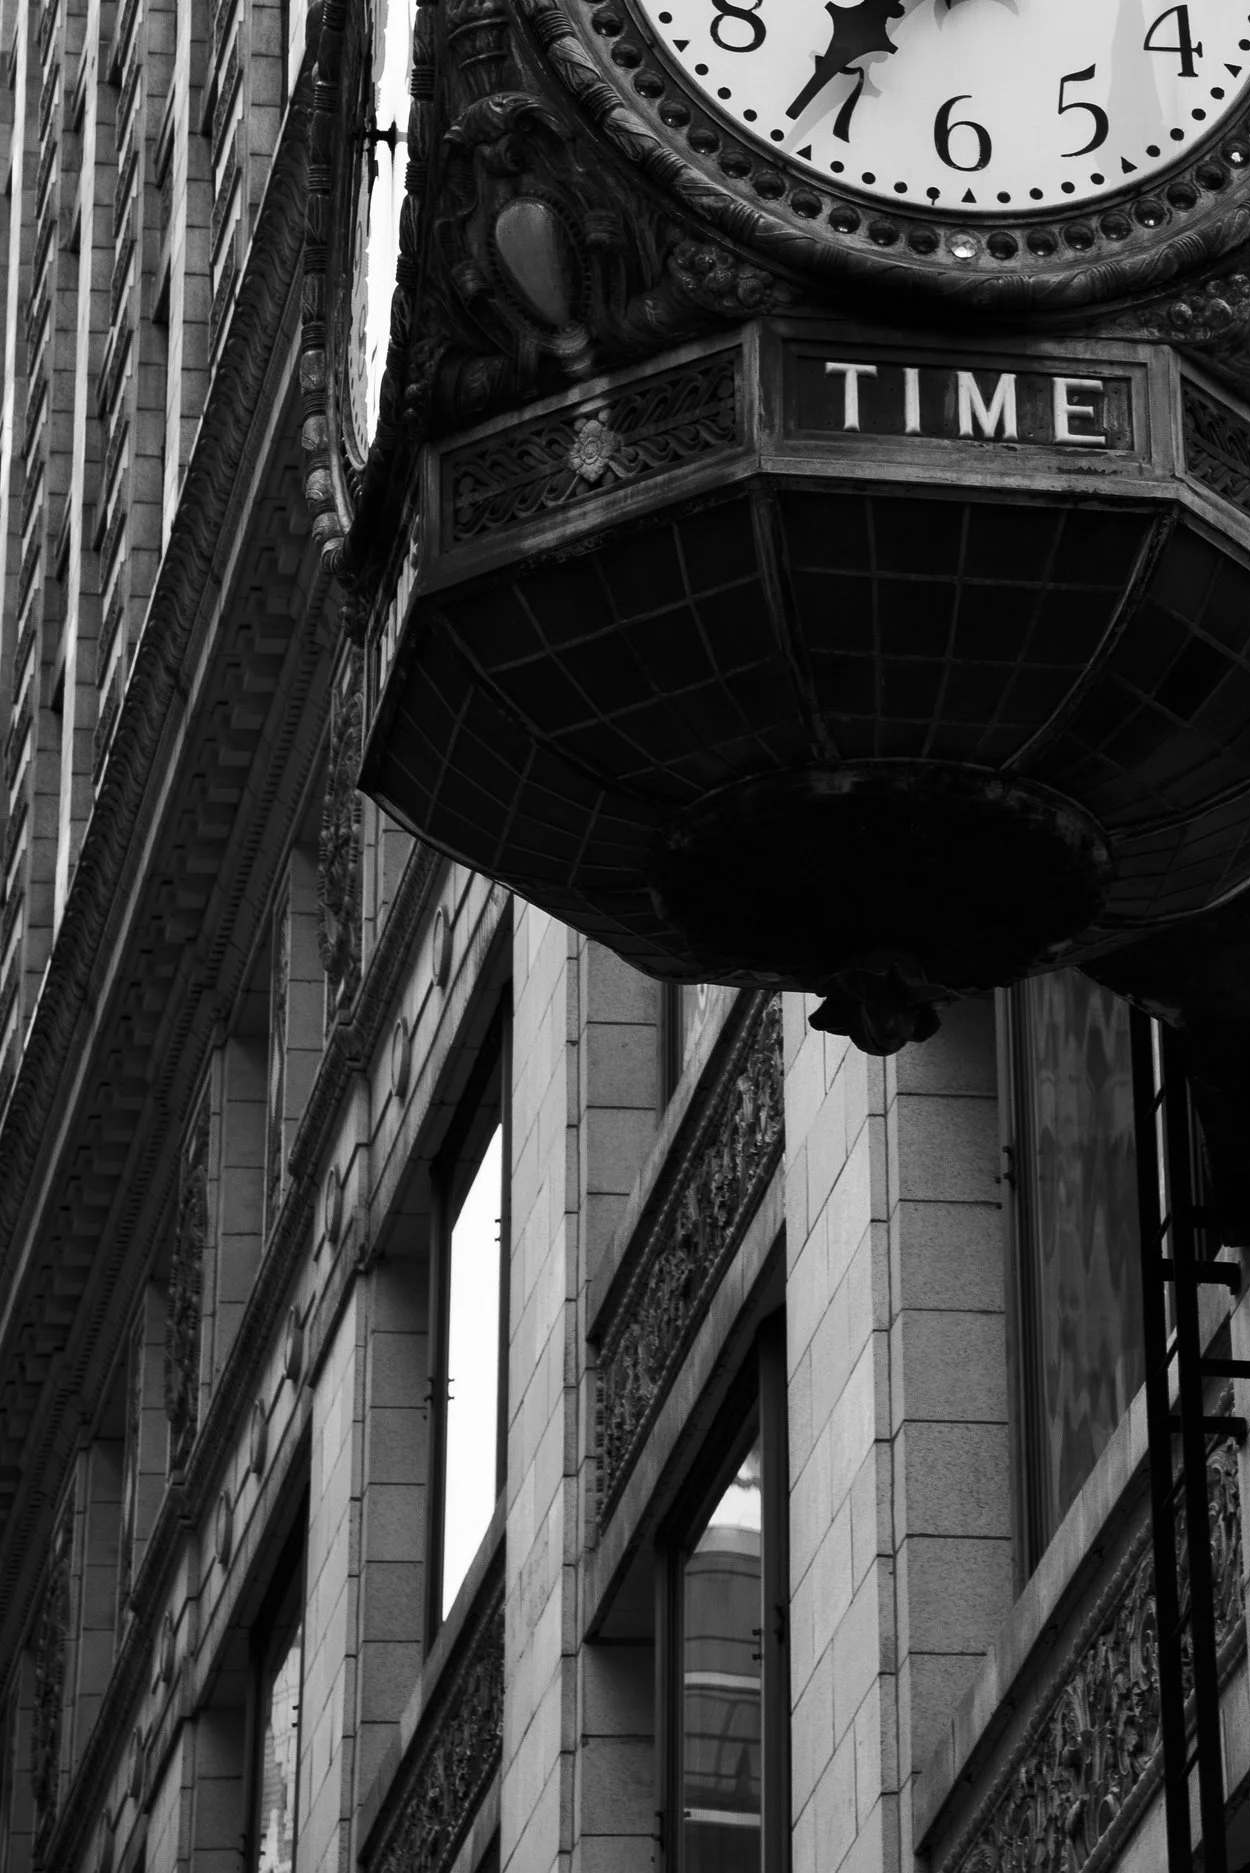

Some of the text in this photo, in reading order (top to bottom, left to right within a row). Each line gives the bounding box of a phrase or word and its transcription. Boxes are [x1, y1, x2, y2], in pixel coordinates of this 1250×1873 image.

[1143, 4, 1203, 78] 4
[815, 54, 865, 144] 7
[933, 94, 993, 172] 6
[1058, 63, 1109, 158] 5
[825, 361, 1105, 445] TIME
